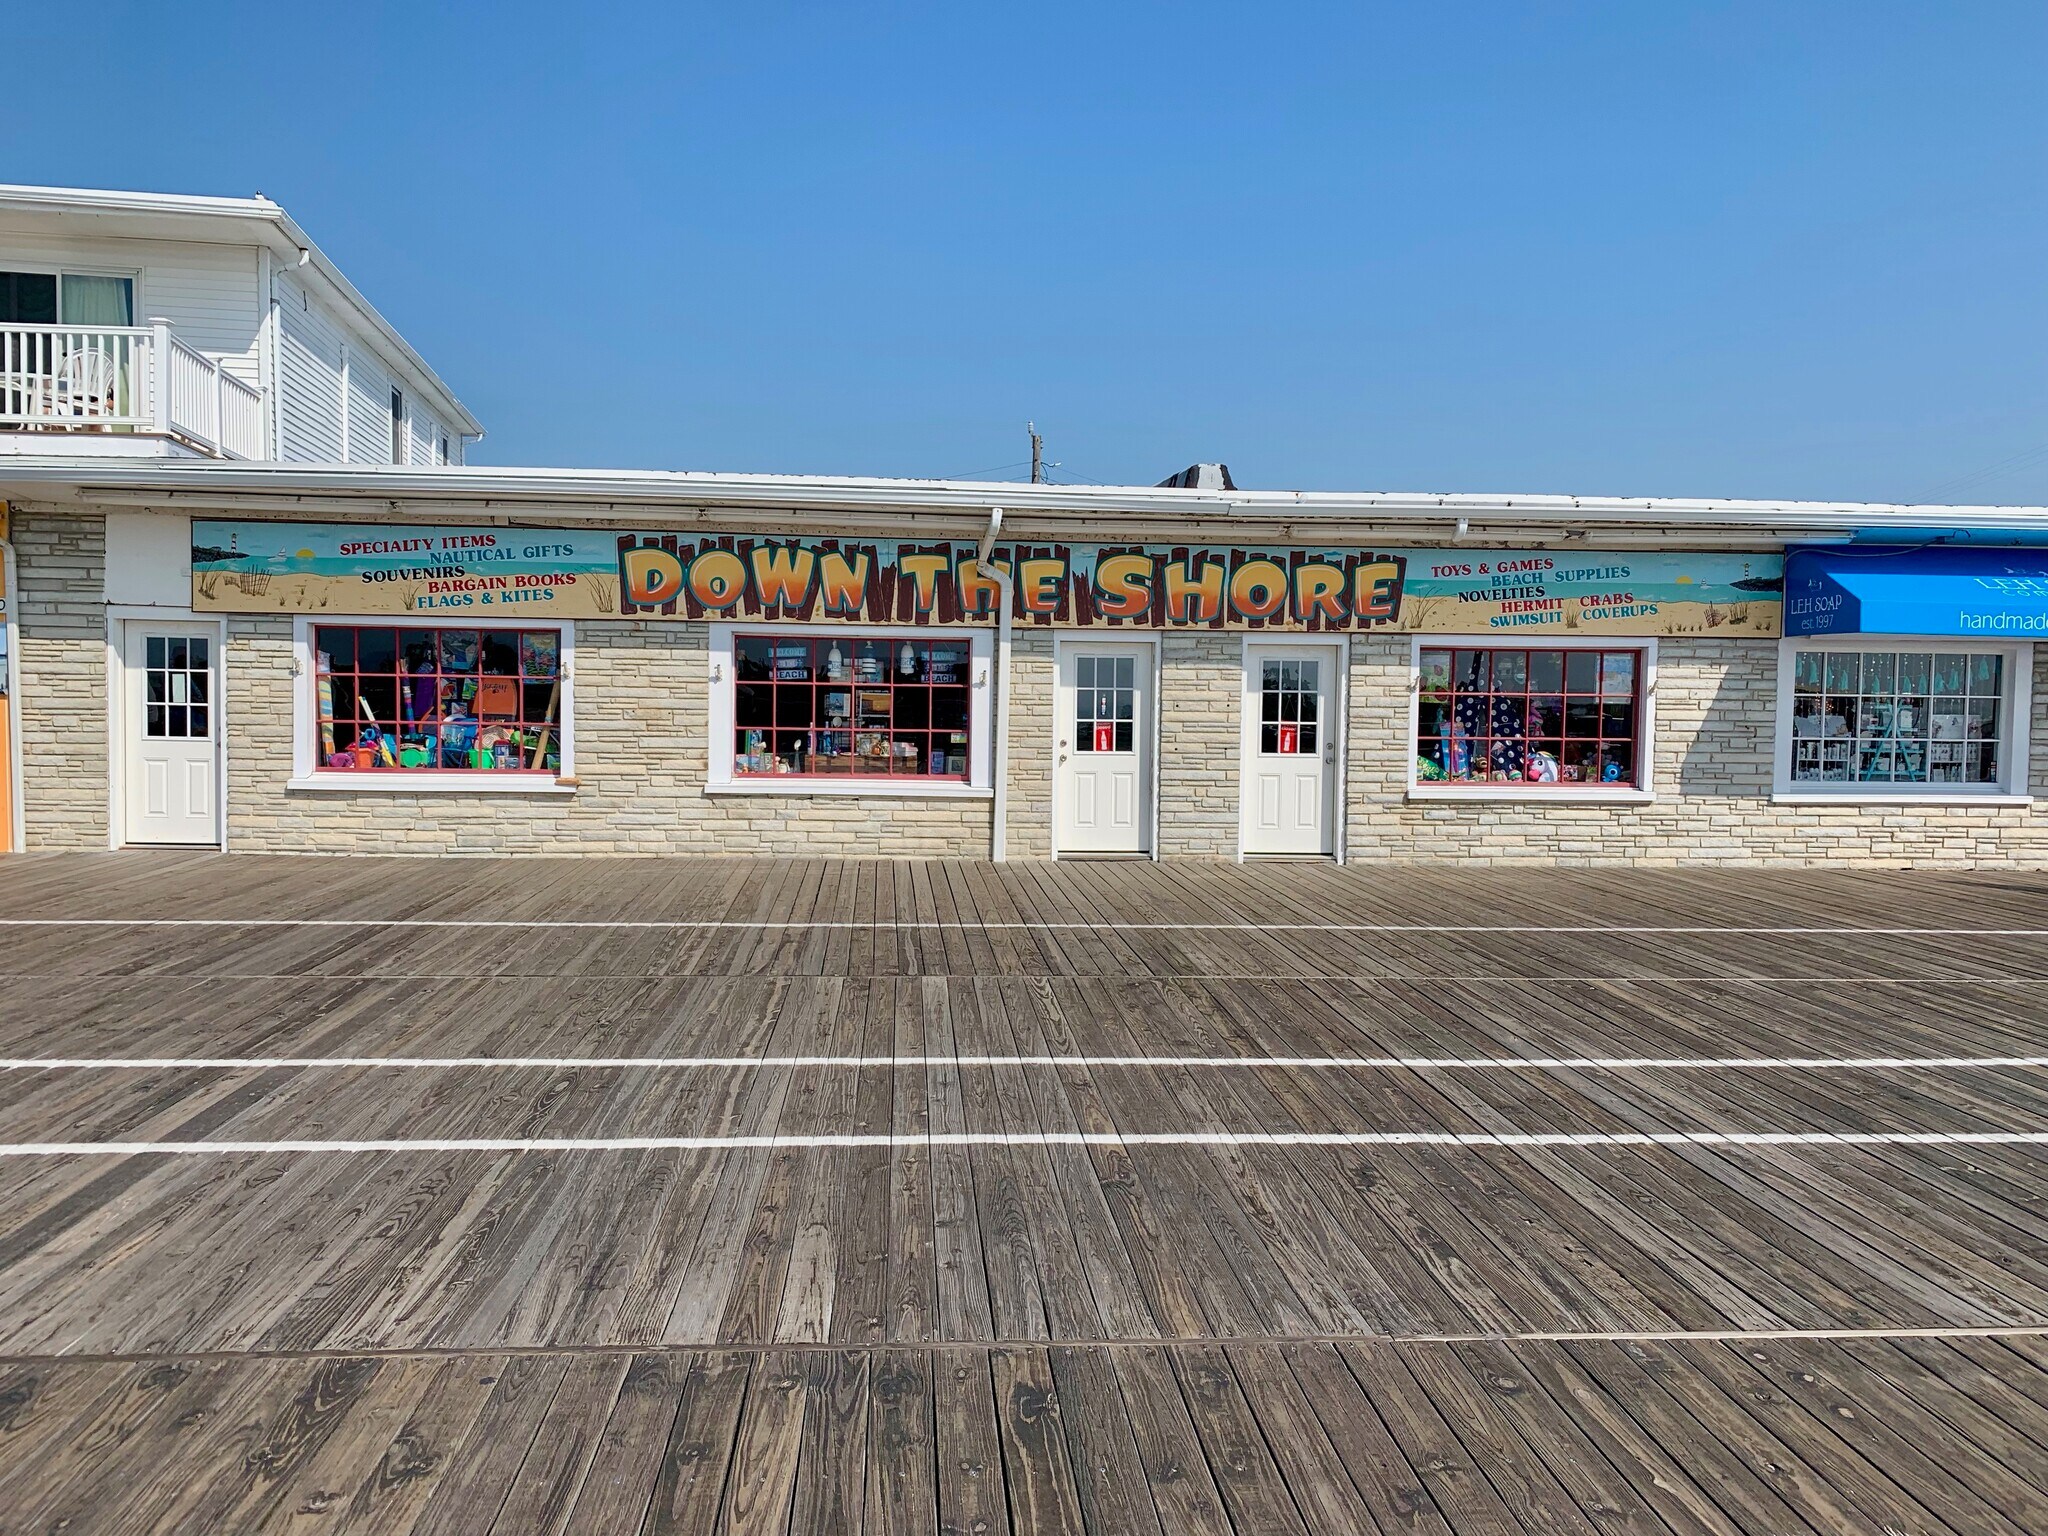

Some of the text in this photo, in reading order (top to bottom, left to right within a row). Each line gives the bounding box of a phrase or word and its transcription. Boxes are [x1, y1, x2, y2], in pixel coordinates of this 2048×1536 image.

[340, 534, 497, 556] SPECIALTY ITEMS
[430, 543, 574, 564] NAUTICAL GIFTS
[361, 565, 466, 583] SOUVENIRS
[1431, 557, 1554, 578] TOYS & GAMES
[1491, 566, 1631, 587] BEACH SUPPLIES
[428, 572, 577, 593] BARGAIN BOOKS
[622, 544, 1401, 623] DOWN THE SHORE
[1973, 578, 2046, 590] LEH
[417, 588, 554, 609] FLAGS & KITES
[1458, 585, 1546, 603] NOVELTIES
[1501, 592, 1634, 613] HERMIT CRABS
[1791, 594, 1843, 615] LEH SOAP
[1490, 603, 1659, 628] SWIMSUIT COVERUPS
[1815, 614, 1834, 629] 1997
[1960, 610, 2048, 630] handmad
